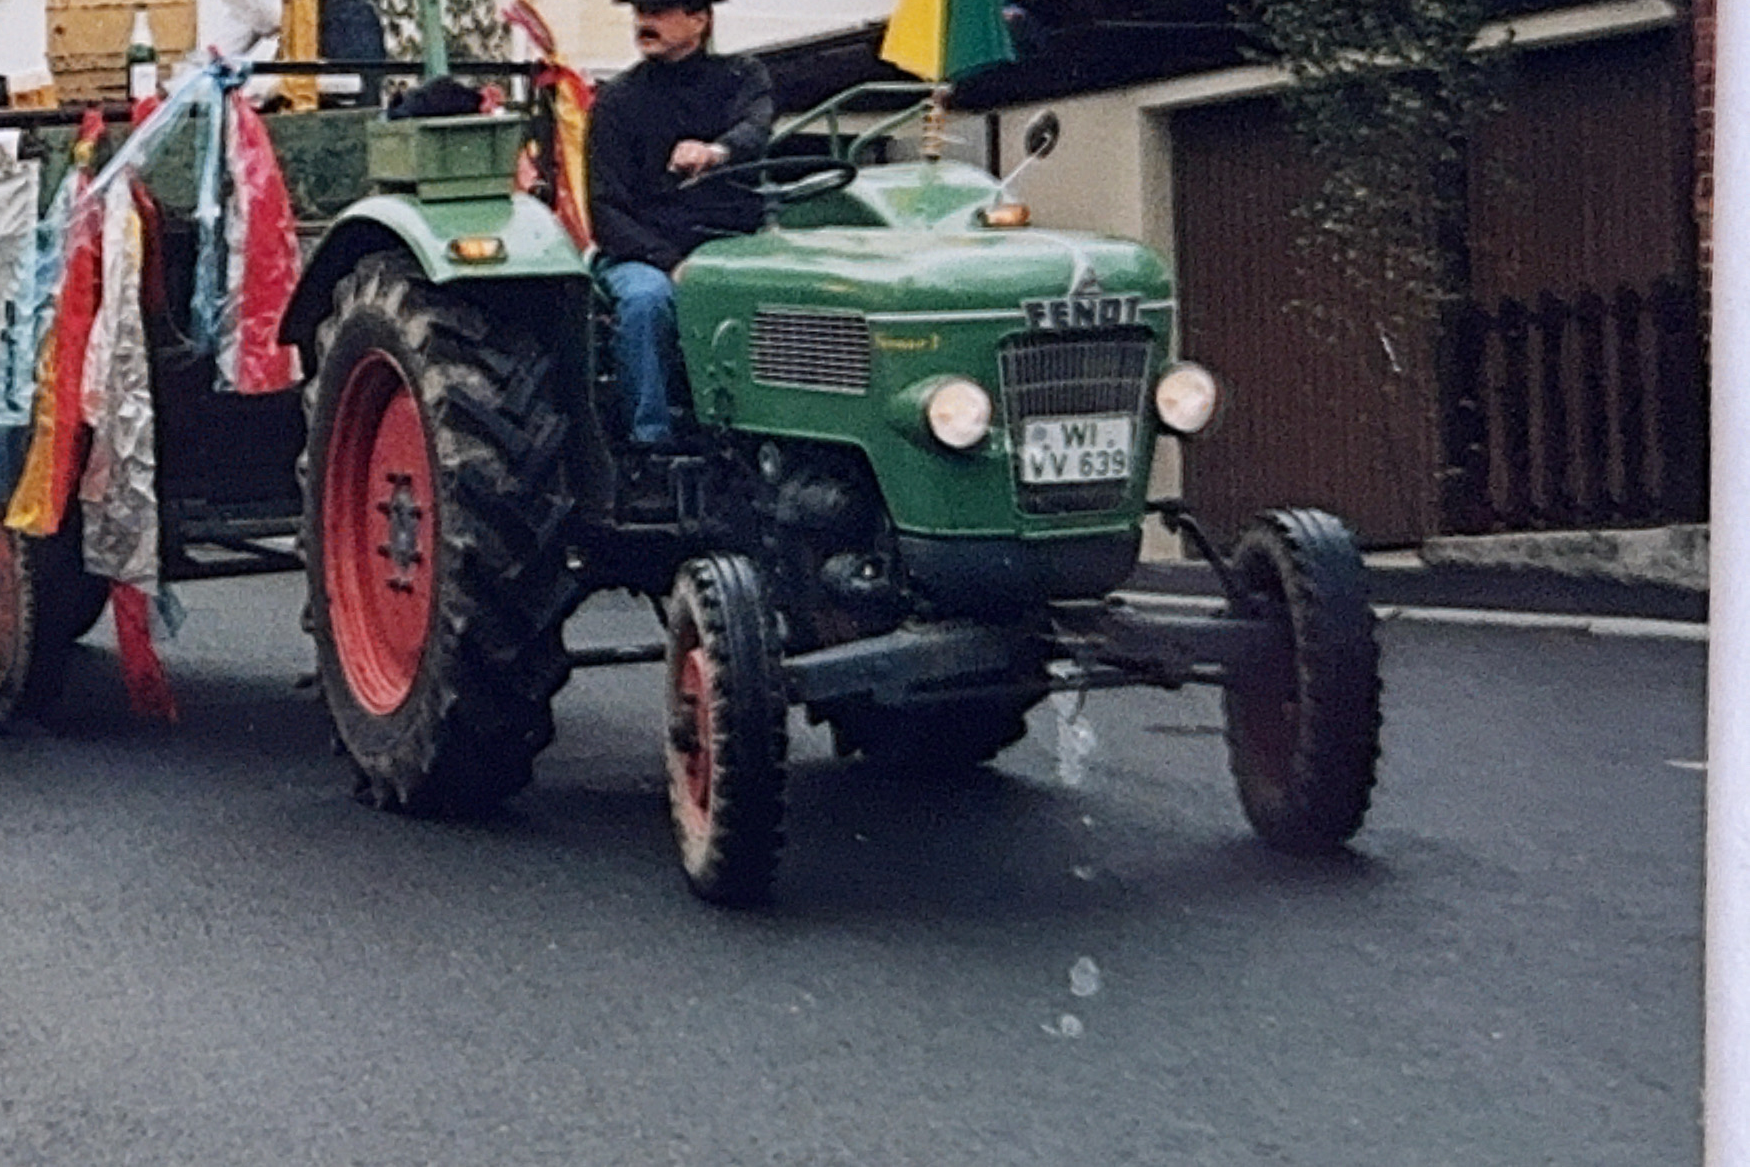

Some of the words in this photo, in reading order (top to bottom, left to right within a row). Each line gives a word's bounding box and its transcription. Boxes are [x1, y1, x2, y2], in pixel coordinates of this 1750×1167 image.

[1024, 297, 1142, 330] FENDT
[1061, 422, 1098, 450] WI
[1079, 449, 1126, 477] 639
